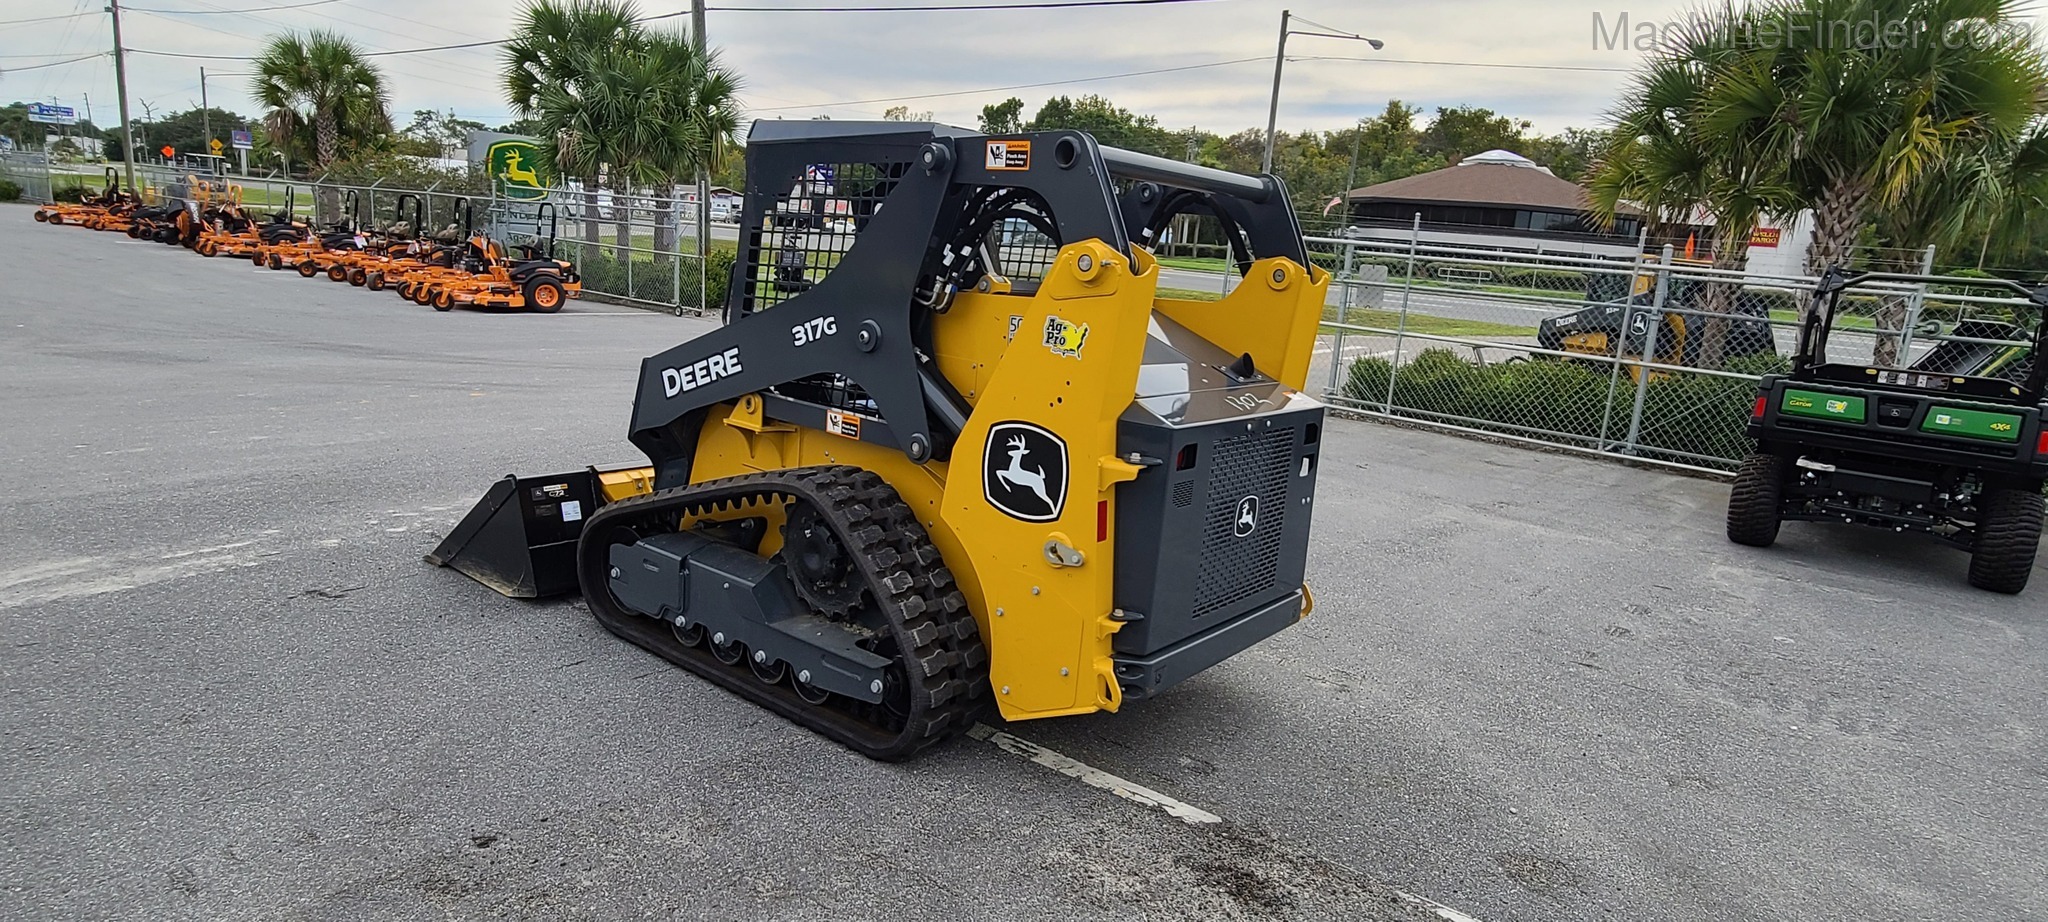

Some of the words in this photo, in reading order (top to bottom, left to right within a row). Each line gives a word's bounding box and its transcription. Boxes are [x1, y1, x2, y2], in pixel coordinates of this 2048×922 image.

[791, 316, 838, 347] 317G
[1045, 331, 1066, 346] Pro
[661, 347, 743, 398] DEERE
